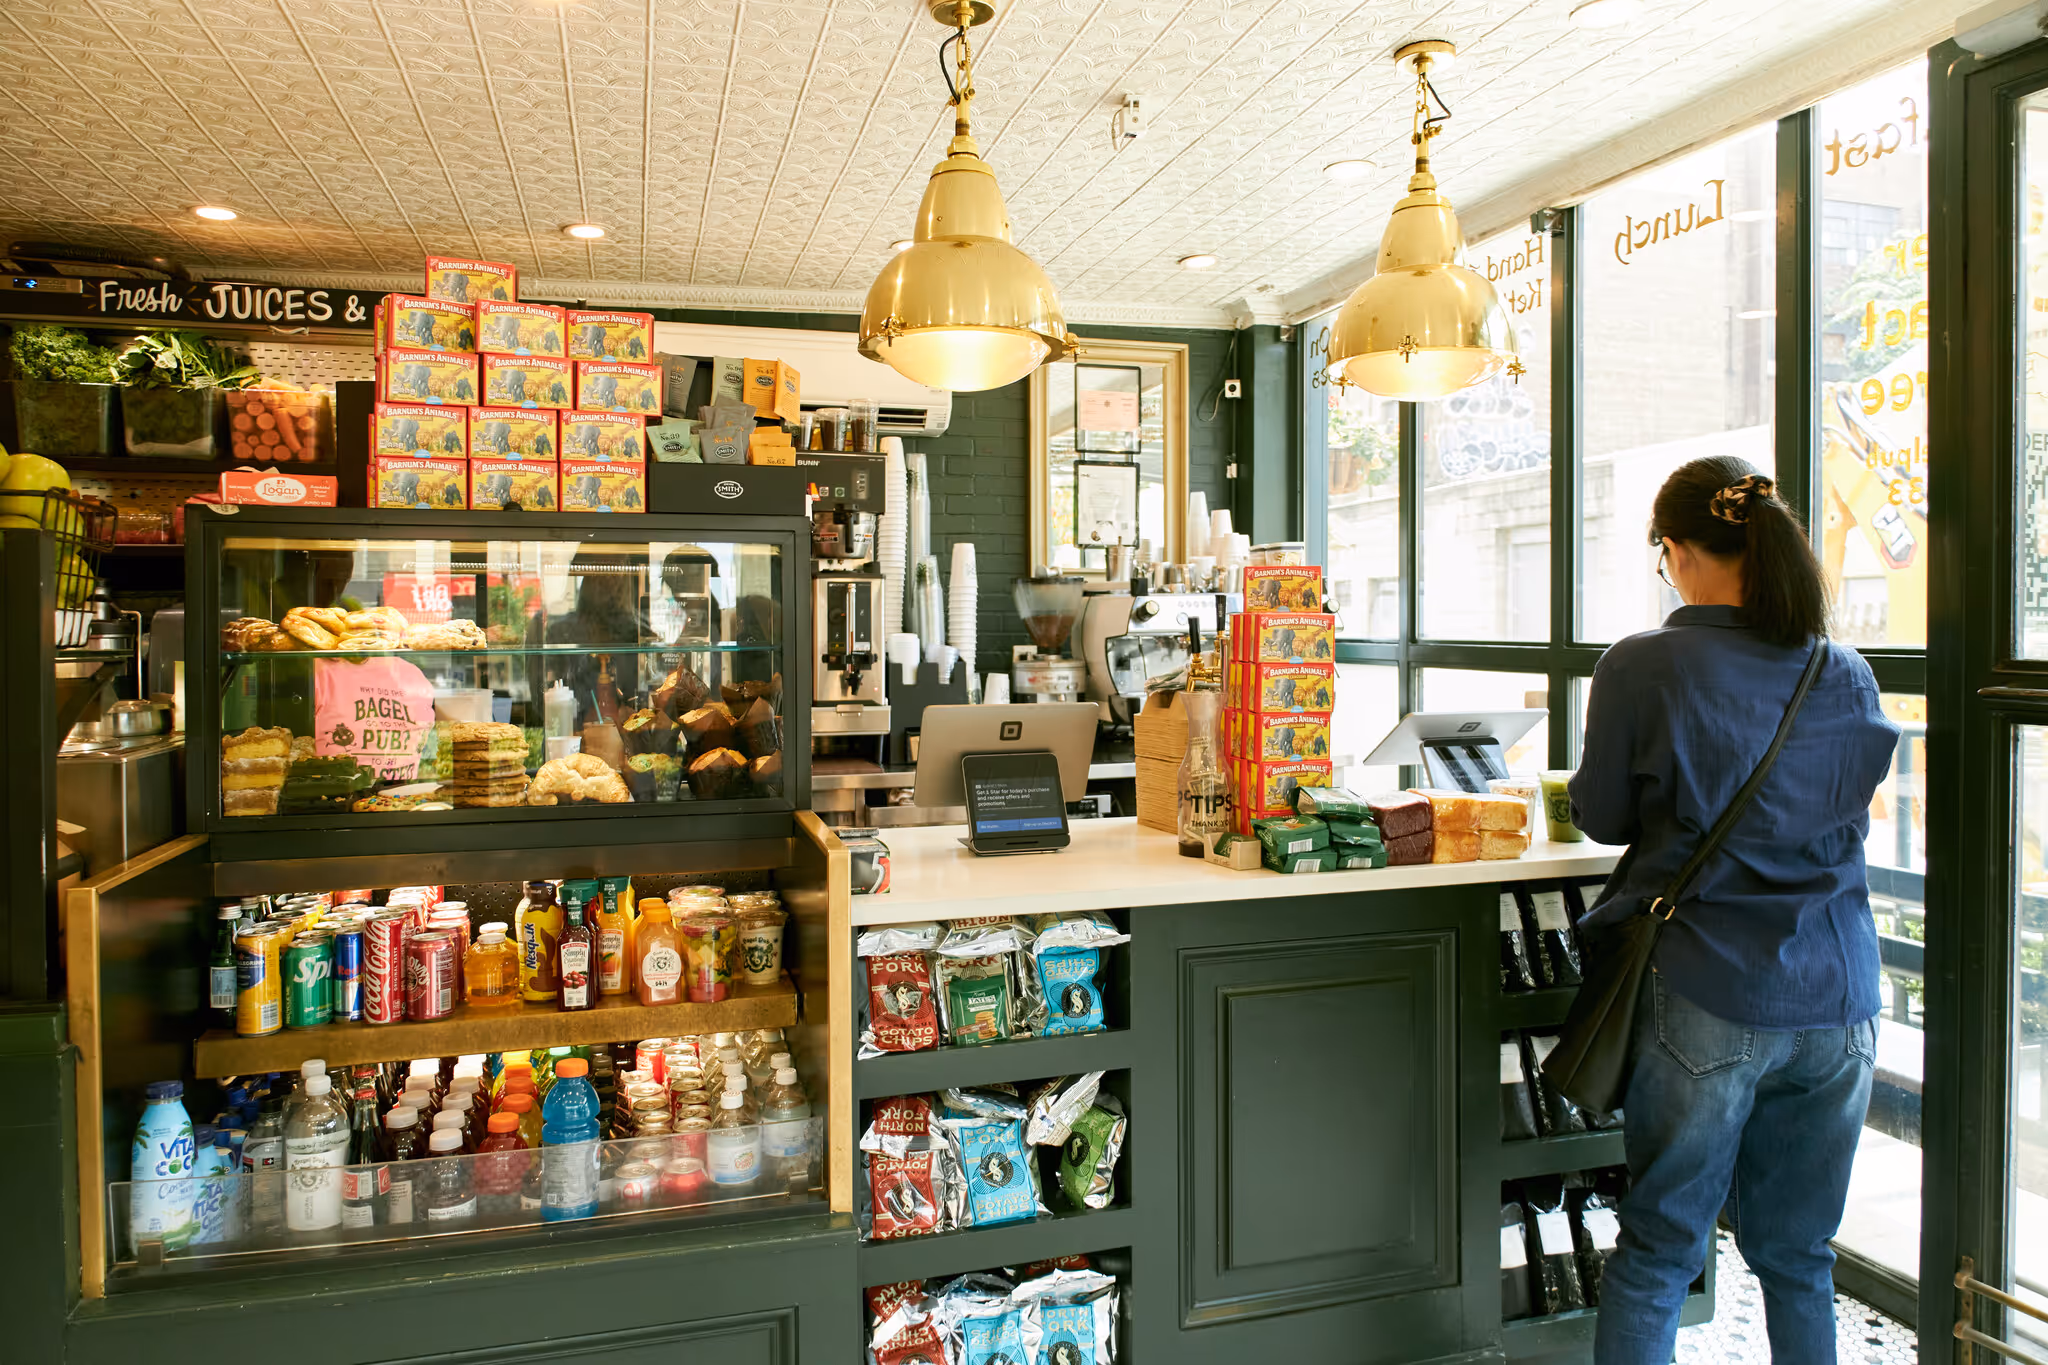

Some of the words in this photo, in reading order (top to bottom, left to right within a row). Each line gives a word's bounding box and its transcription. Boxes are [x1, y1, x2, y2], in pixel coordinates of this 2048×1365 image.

[438, 262, 473, 271] BARNUM'S
[474, 263, 505, 276] ANIMALS
[100, 280, 182, 313] Fresh
[205, 284, 333, 321] JUICES
[345, 295, 366, 322] &
[404, 300, 439, 310] BARNUM'S
[441, 302, 471, 317] ANIMALS
[489, 304, 525, 314] BARNUM'S
[526, 306, 557, 320] ANIMALS
[577, 315, 610, 324] BARNUM'S
[610, 315, 641, 326] ANIMALS
[399, 353, 436, 361] BARNUM'S
[436, 354, 469, 366] ANIMALS
[495, 358, 530, 367] BARNUM'S
[531, 359, 563, 371] ANIMALS
[588, 365, 622, 374] BARNUM'S
[623, 366, 653, 378] ANIMALS
[386, 407, 424, 416] BARNUM'S
[424, 407, 457, 419] ANIMALS
[479, 411, 515, 420] BARNUM'S
[516, 411, 547, 422] ANIMALS
[570, 414, 604, 423] BARNUM'S
[605, 414, 635, 425] ANIMALS
[387, 460, 424, 470] BARNUM'S
[425, 461, 457, 472] ANIMALS
[481, 463, 518, 472] BARNUM'S
[518, 463, 549, 474] ANIMALS
[571, 464, 605, 473] BARNUM'S
[606, 464, 636, 474] ANIMALS
[262, 482, 301, 497] Logan
[1254, 568, 1284, 577] BARNUM'S
[1285, 568, 1313, 577] ANIMALS
[1268, 617, 1298, 627] BARNUM'S
[1300, 618, 1327, 627] ANIMALS
[1270, 667, 1299, 677] BARNUM'S
[1300, 667, 1327, 676] ANIMALS
[354, 697, 417, 725] BAGEL
[1270, 716, 1298, 726] BARNUM'S
[1299, 716, 1324, 725] ANIMALS
[361, 729, 411, 750] PUB?
[1272, 765, 1300, 775] BARNUM'S
[1301, 764, 1326, 773] ANIMALS
[1190, 793, 1233, 814] TIPS
[868, 852, 887, 894] 5
[524, 922, 537, 970] Nesquik
[871, 961, 925, 975] FORK
[1044, 958, 1095, 968] CHIPS
[880, 1026, 934, 1037] POTATO
[881, 1035, 933, 1046] CHIPS
[881, 1107, 924, 1120] FORK
[880, 1121, 925, 1132] NORTH
[160, 1136, 194, 1159] VITA
[876, 1160, 928, 1171] POTATO
[975, 1193, 1030, 1212] POTATO
[977, 1202, 1030, 1221] CHIPS
[879, 1281, 910, 1305] ORK
[970, 1320, 1015, 1338] CHIPS
